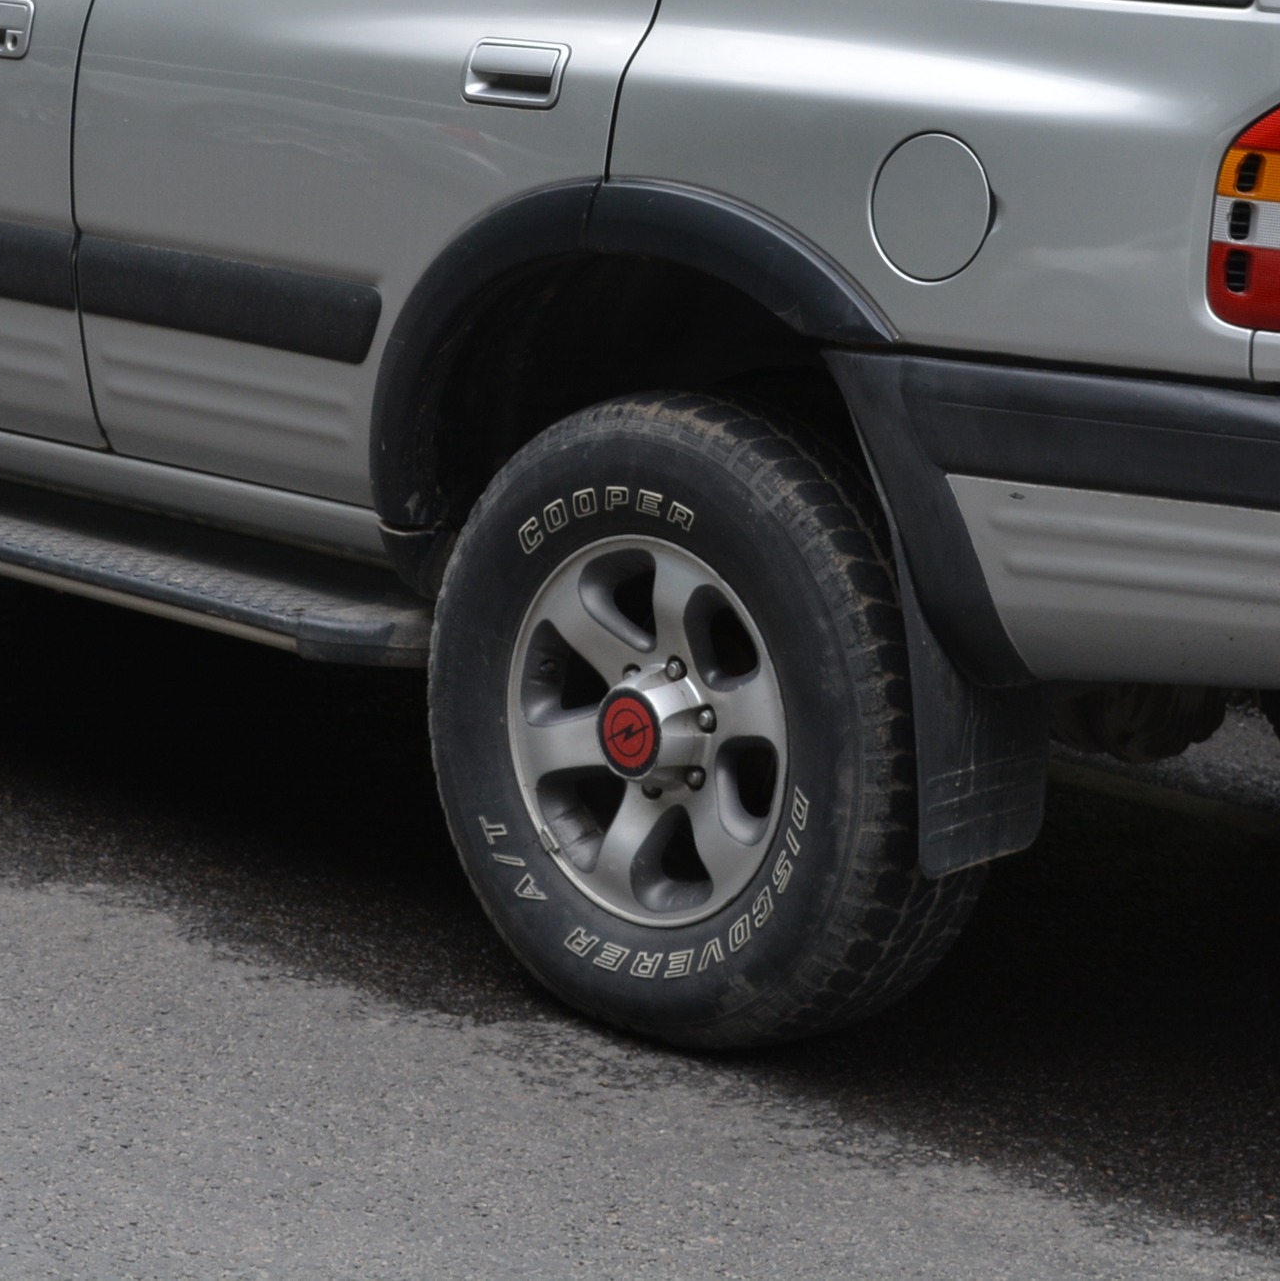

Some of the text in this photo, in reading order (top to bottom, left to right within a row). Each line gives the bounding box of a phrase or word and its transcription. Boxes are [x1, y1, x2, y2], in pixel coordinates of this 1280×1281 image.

[518, 485, 695, 555] COOPER
[478, 785, 810, 979] DISCOVERER A/T
